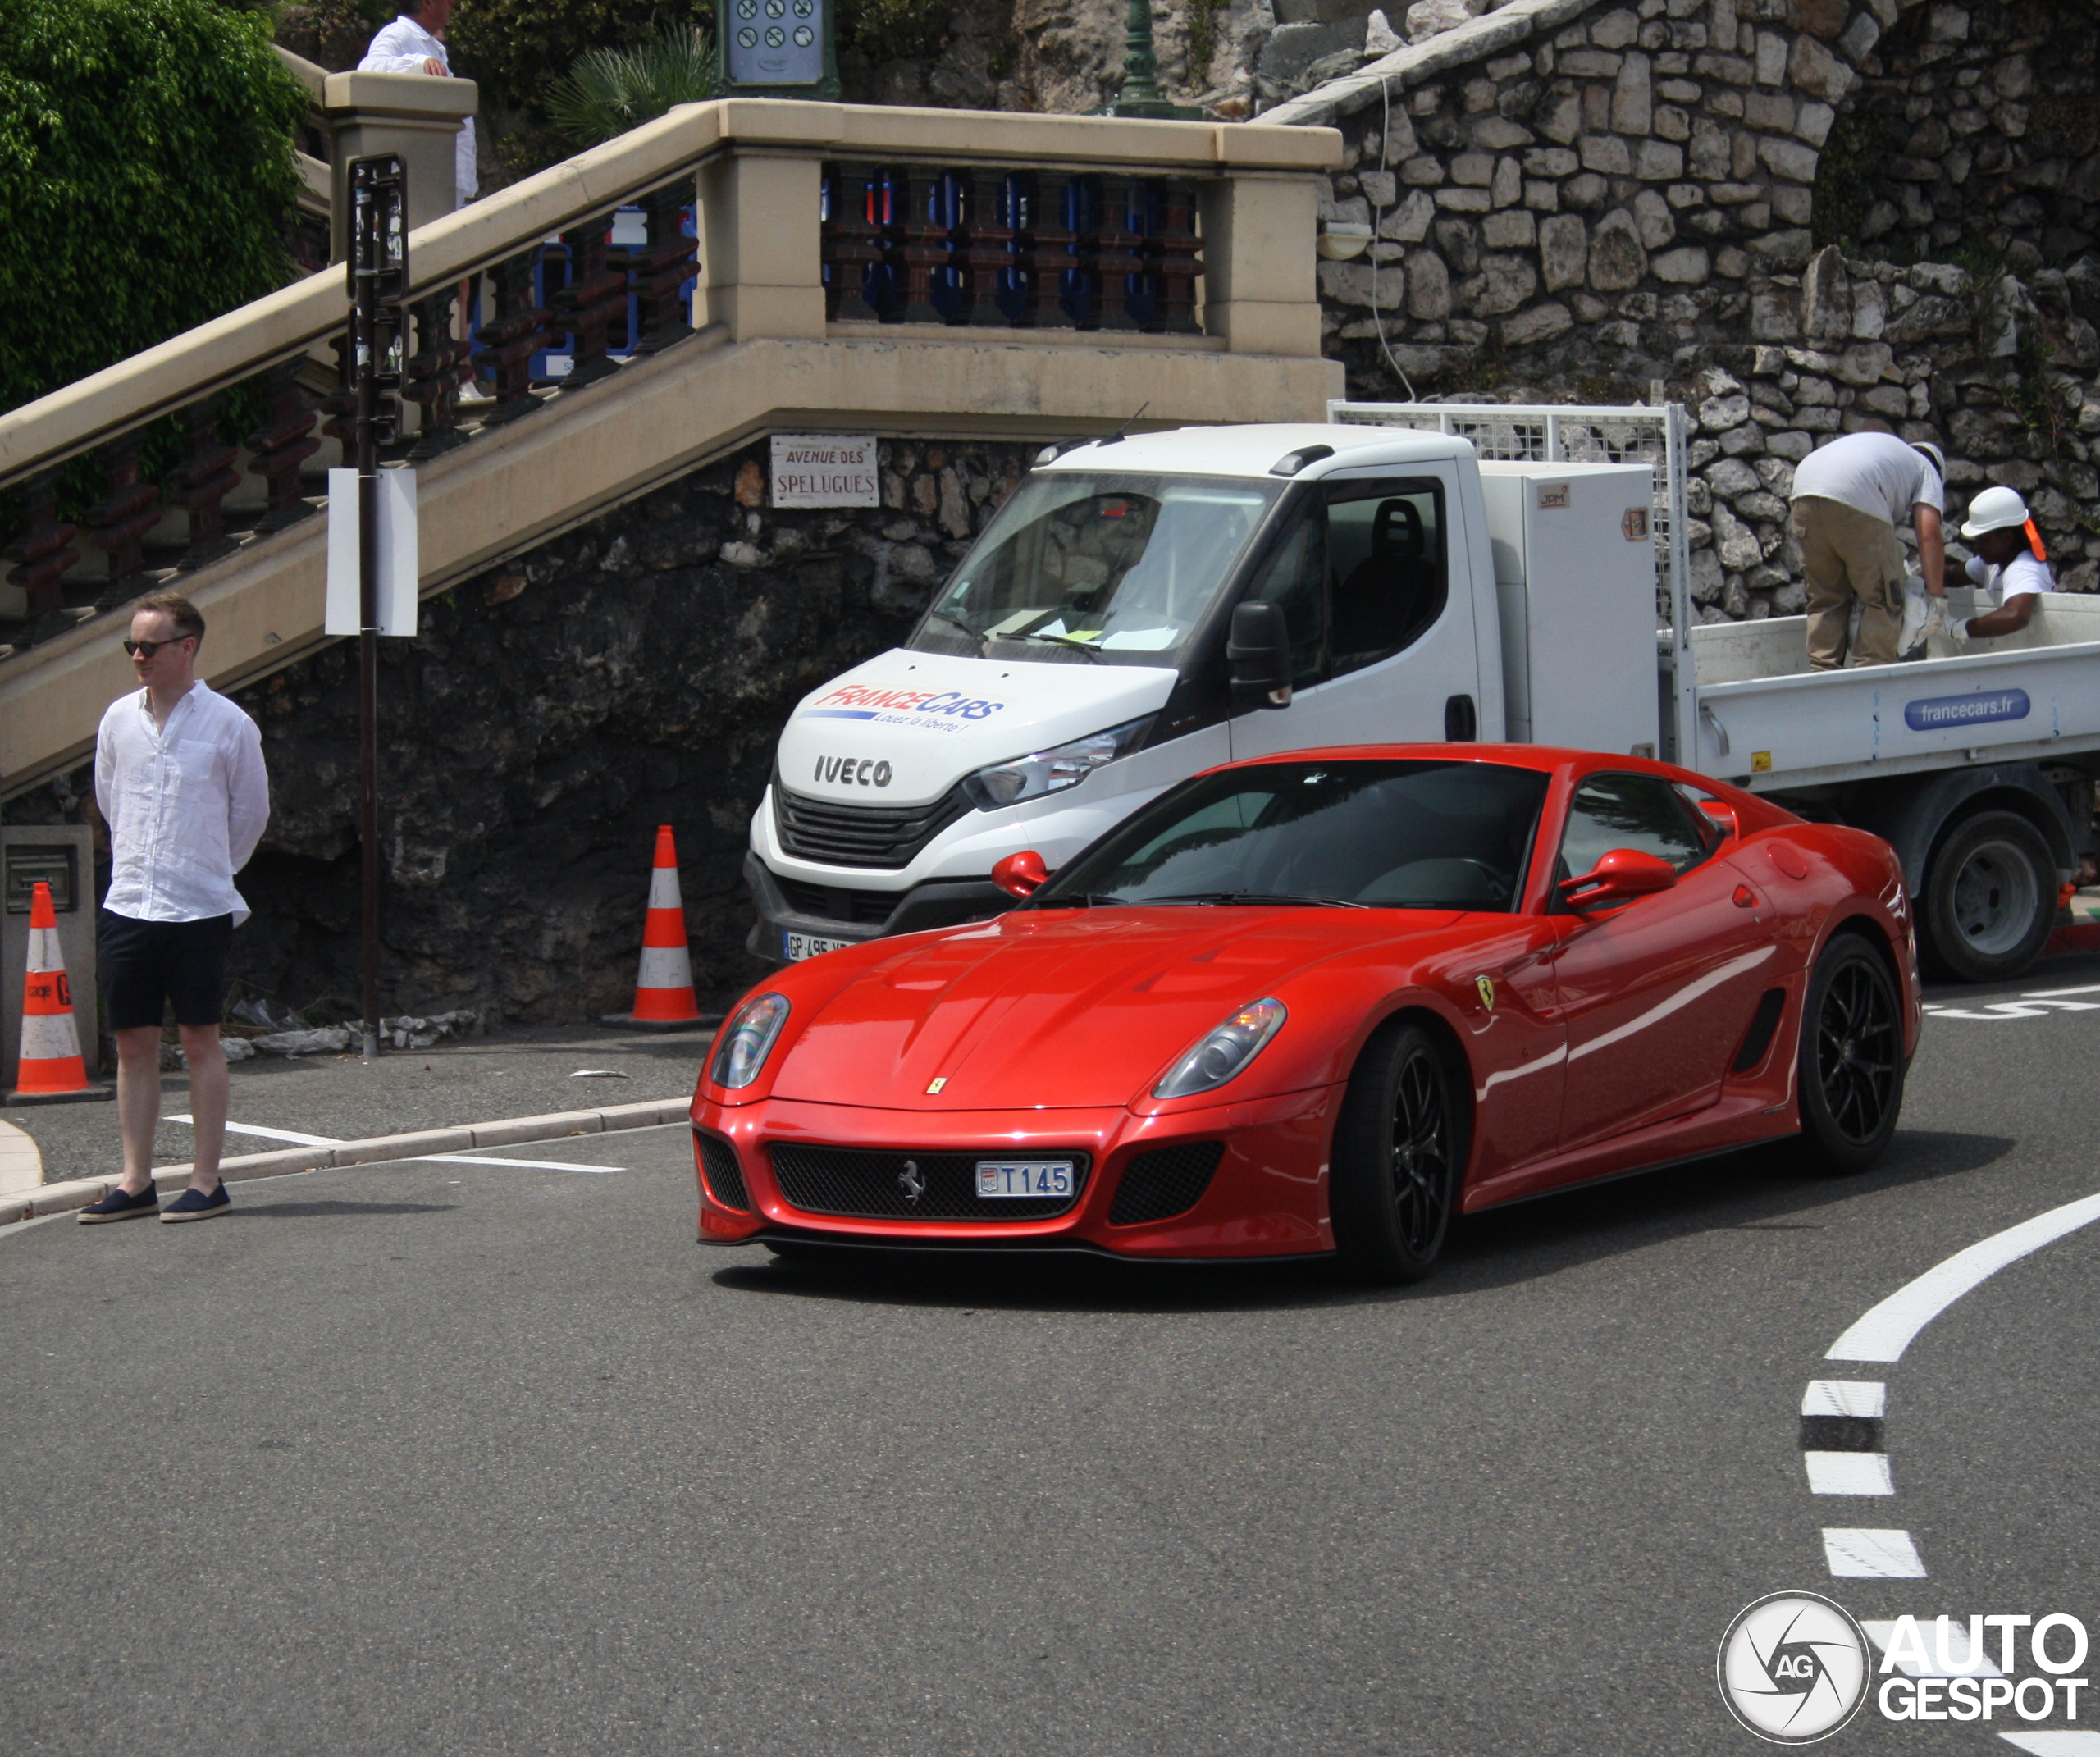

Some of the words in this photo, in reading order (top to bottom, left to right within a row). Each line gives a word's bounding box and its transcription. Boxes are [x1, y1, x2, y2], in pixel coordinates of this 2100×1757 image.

[786, 450, 836, 463] AVENUE
[840, 451, 864, 464] DES
[778, 475, 874, 494] SPELUGUES
[1541, 494, 1564, 504] JPM
[1920, 696, 2014, 722] francecars.fr
[874, 712, 910, 724] Louez
[907, 716, 923, 726] la
[814, 755, 892, 787] IVECO
[983, 1179, 996, 1188] MC
[1001, 1166, 1068, 1192] T145
